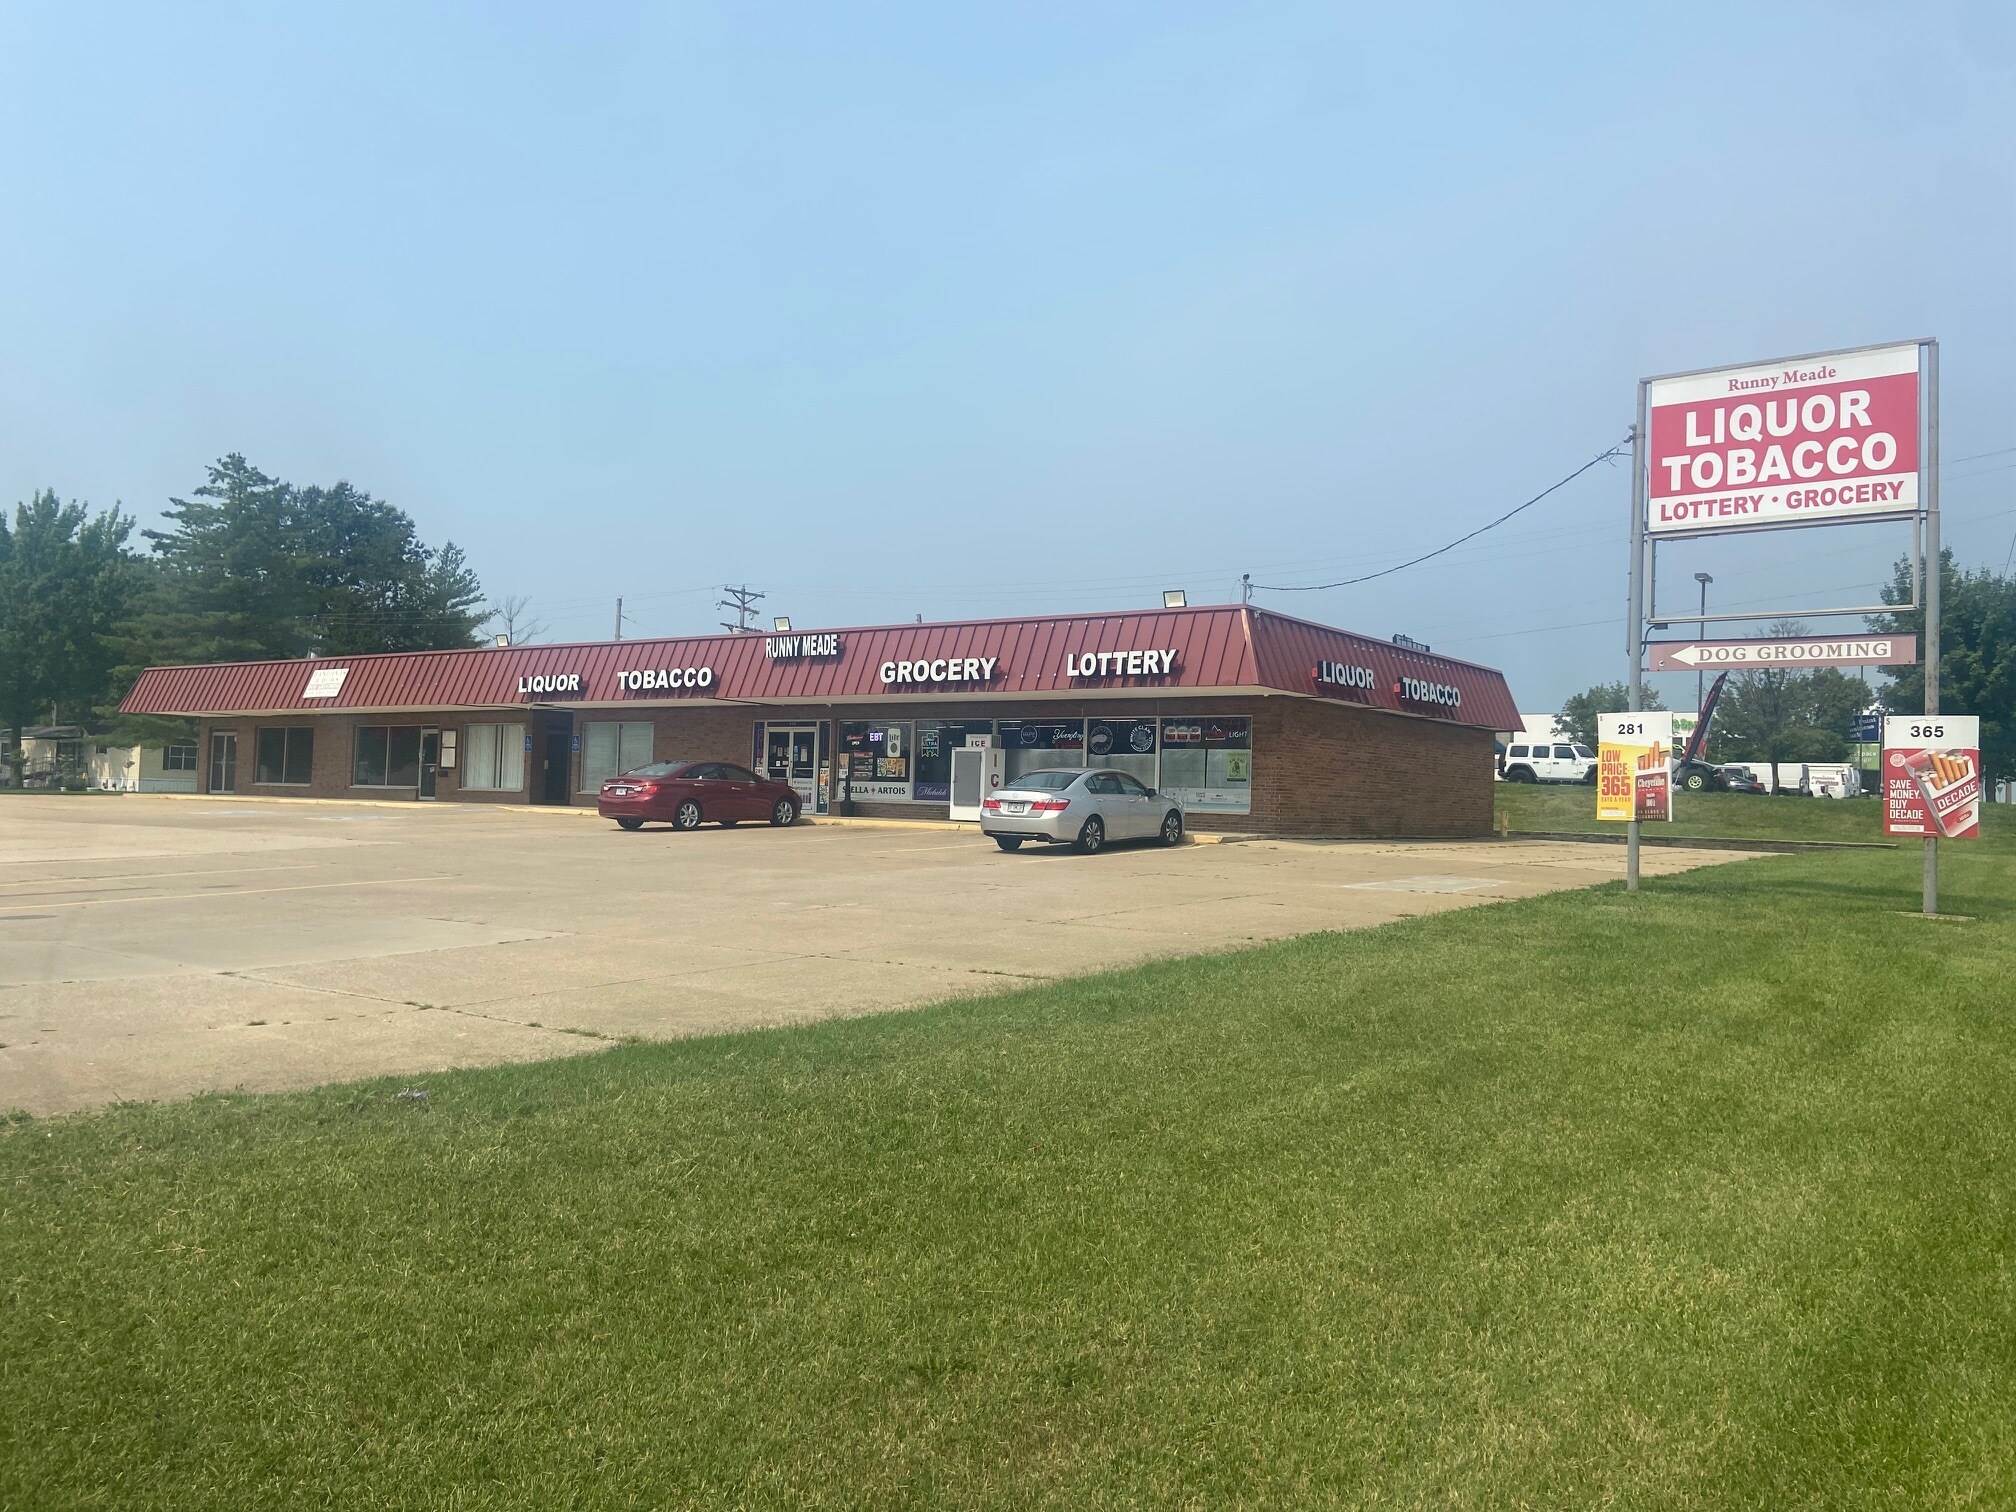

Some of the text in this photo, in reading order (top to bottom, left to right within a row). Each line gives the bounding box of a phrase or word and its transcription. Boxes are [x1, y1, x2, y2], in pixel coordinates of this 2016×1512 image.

[1728, 366, 1837, 392] Runny Meade
[1685, 389, 1873, 447] LIQUOR
[1661, 432, 1897, 491] TOBACCO
[1660, 480, 1905, 522] LOTTERY GROCERY
[765, 634, 838, 658] RUNNY MEADE
[1699, 642, 1889, 662] DOG GROOMING
[880, 656, 998, 684] GROCERY
[1066, 648, 1177, 677] LOTTERY
[518, 674, 580, 693] LIQUOR
[617, 666, 713, 690] TOBACCO
[1322, 660, 1376, 690] LIQUOR
[1402, 676, 1461, 707] TOBACCO
[869, 732, 884, 741] EBT
[889, 733, 900, 742] Lite
[1053, 729, 1084, 741] Yuengling
[1618, 724, 1643, 734] 281
[1910, 726, 1944, 738] 365
[1601, 750, 1621, 762] LOW
[991, 754, 1000, 787] IC
[1601, 763, 1628, 775] PRICE
[842, 786, 906, 795] SELLA ARTOIS
[1601, 776, 1631, 796] 365
[1637, 777, 1665, 788] Cheyenne
[1890, 780, 1911, 789] SAVE
[1890, 789, 1921, 799] MONEY.
[1937, 780, 1977, 810] DECADE
[1890, 800, 1907, 809] BUY
[1890, 809, 1923, 819] DECADE
